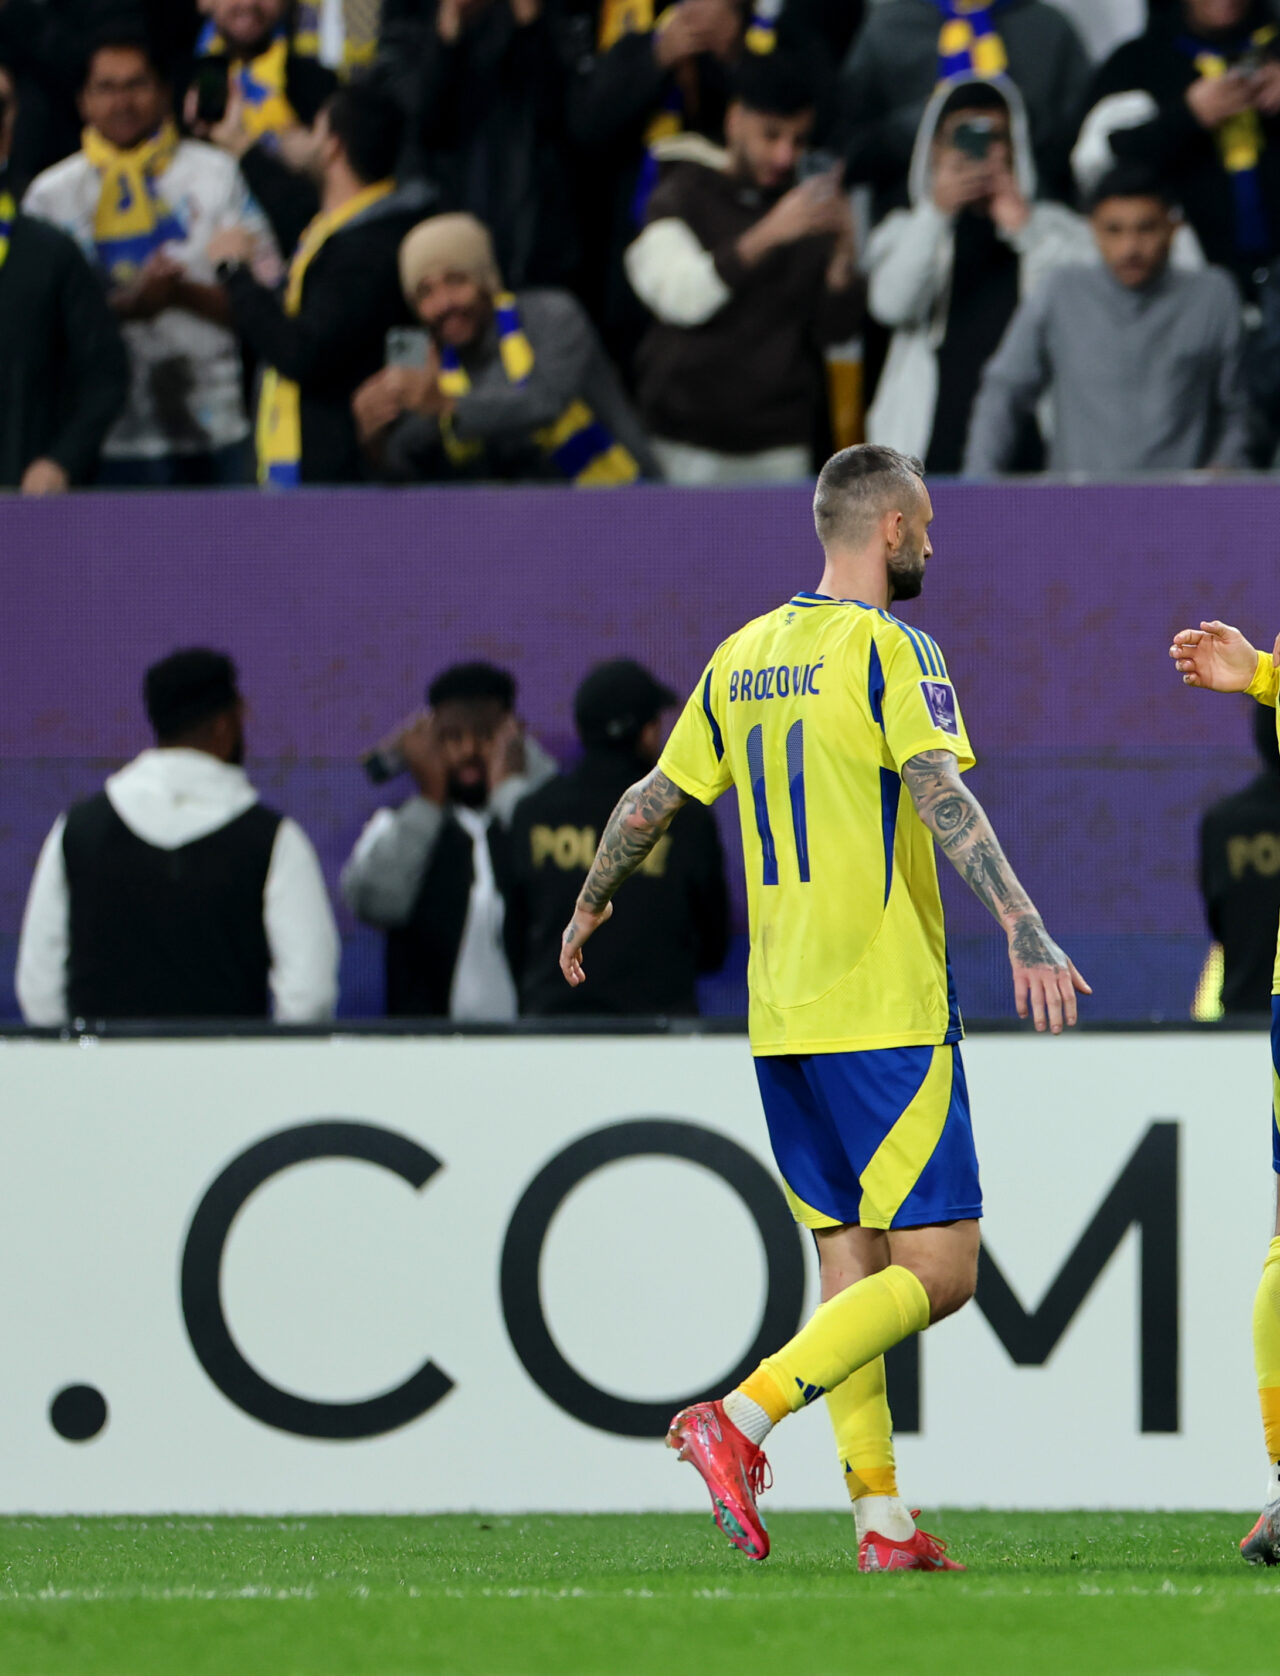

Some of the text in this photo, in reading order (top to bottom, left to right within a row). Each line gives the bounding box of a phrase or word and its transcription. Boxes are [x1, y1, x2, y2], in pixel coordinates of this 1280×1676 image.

[729, 655, 825, 702] BROZOVIĆ
[746, 718, 811, 885] 11
[49, 1116, 1181, 1442] .COM
